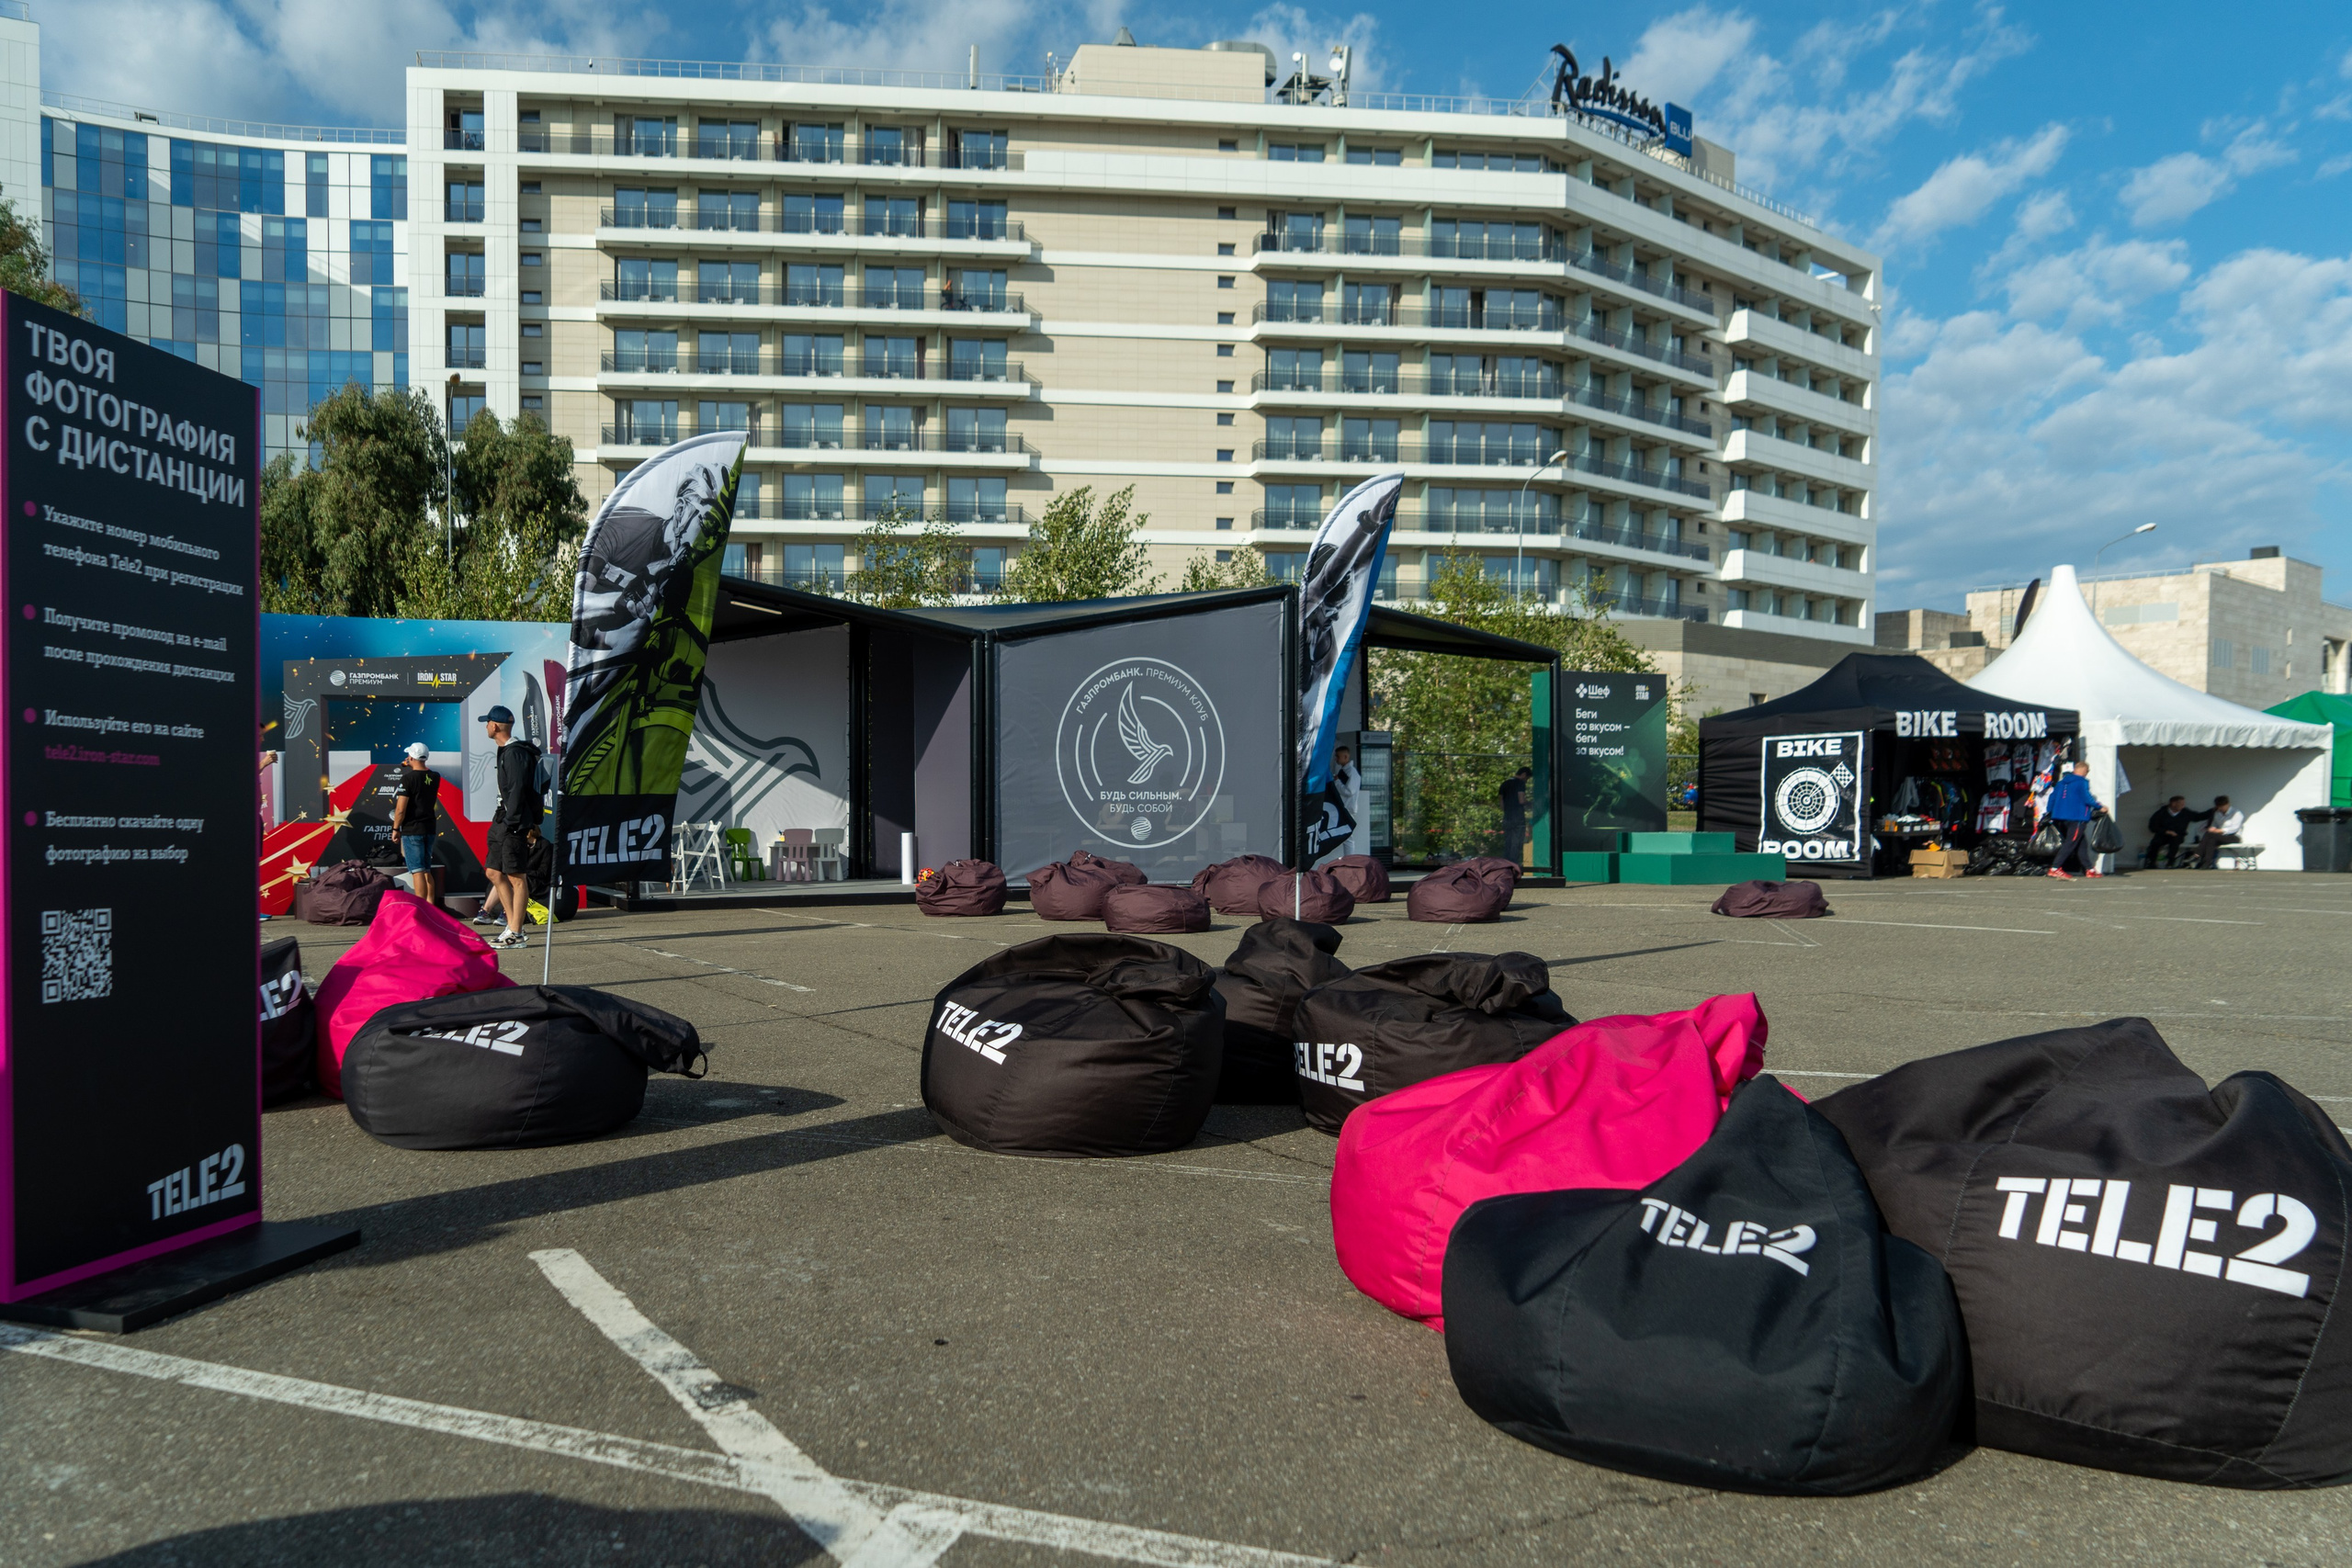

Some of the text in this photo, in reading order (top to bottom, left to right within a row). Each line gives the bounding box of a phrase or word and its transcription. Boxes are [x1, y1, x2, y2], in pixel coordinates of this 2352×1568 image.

[1551, 43, 1667, 133] Radisson
[1669, 121, 1691, 141] BLU
[25, 321, 114, 382] ТВОЯ
[25, 370, 235, 465] ФОТОГРАФИЯ
[25, 415, 244, 507] С ДИСТАНЦИИ
[44, 505, 220, 560] Укажите номер мобильного
[43, 542, 243, 595] телефона Tele2 при регистрации
[44, 607, 227, 651] Получите промокод на e-mail
[44, 646, 235, 682] после прохождения дистанции
[417, 672, 457, 682] IRON STAR
[1146, 668, 1191, 697] ПРЕМИУМ
[1189, 694, 1208, 722] КЛУБ
[1588, 684, 1611, 698] Шеф
[1635, 692, 1649, 700] STAR
[45, 709, 205, 739] Используйте его на сайте
[1576, 708, 1598, 718] Беги
[1895, 711, 2047, 739] BIKE ROOM
[1576, 723, 1588, 731] со
[1589, 724, 1622, 734] вкусом
[1576, 733, 1597, 743] беги
[1576, 745, 1624, 758] за вкусом!
[1777, 739, 1842, 758] BIKE
[1100, 791, 1126, 801] БУДЬ
[1110, 801, 1172, 813] БУДЬ СОБОЙ
[46, 811, 205, 833] Бесплатно скачайте одну
[568, 814, 665, 864] TELE2
[46, 845, 188, 865] фотографию на выбор
[935, 1000, 1023, 1065] TELE2
[147, 1143, 245, 1221] TELE2
[1641, 1196, 1816, 1278] TELE2
[1996, 1176, 2318, 1298] TELE2
